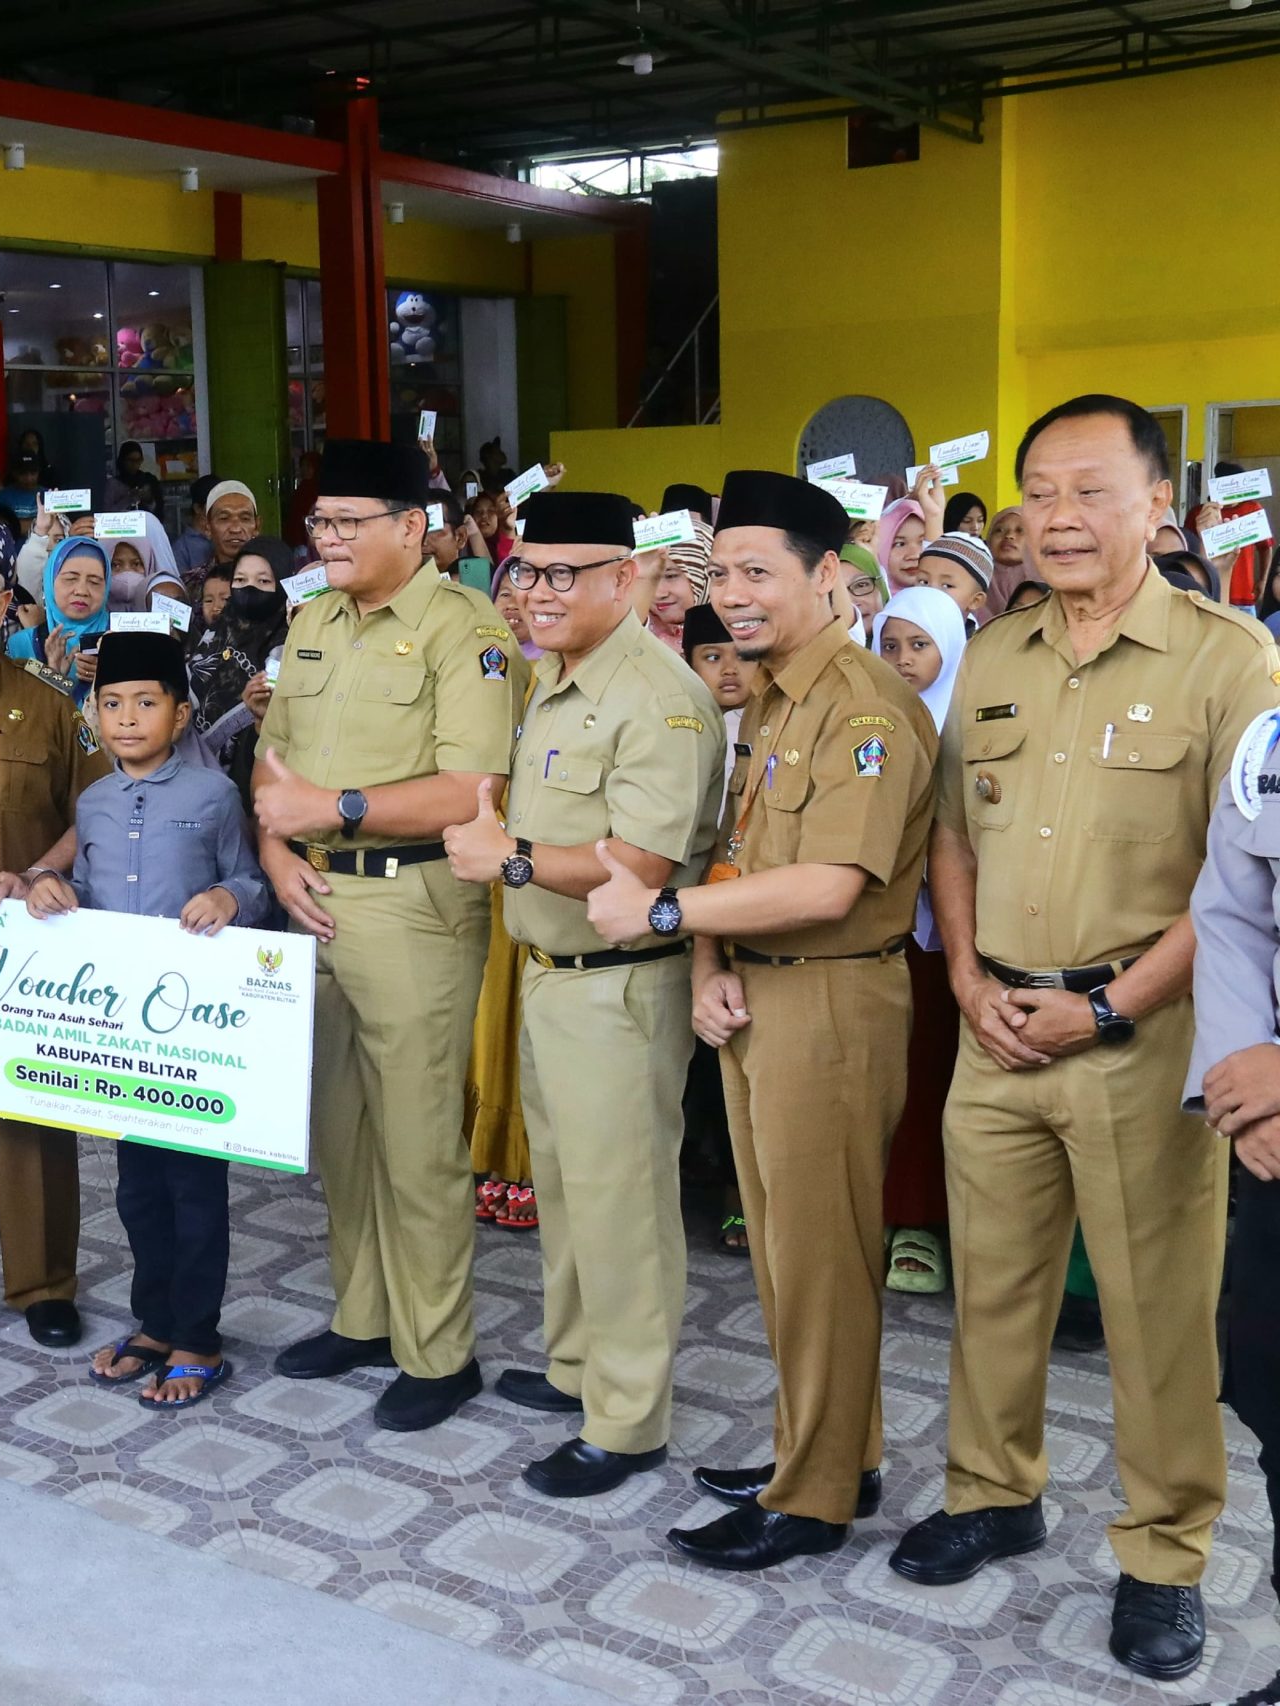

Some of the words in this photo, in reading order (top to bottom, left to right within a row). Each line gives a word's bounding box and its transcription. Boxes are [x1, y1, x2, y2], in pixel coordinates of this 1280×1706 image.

[142, 971, 250, 1034] Oase
[246, 977, 292, 991] BAZNAS
[1, 1003, 34, 1018] Orang
[36, 1008, 56, 1020] Tua
[58, 1012, 86, 1025] Asuh
[87, 1017, 124, 1031] Sehari
[36, 1043, 133, 1071] KABUPATEN
[138, 1060, 198, 1082] BLITAR
[52, 1026, 92, 1044] AMIL
[96, 1033, 152, 1054] ZAKAT
[156, 1043, 248, 1070] NASIONAL
[15, 1064, 79, 1090] Senilai
[95, 1078, 128, 1100] Rp.
[133, 1085, 225, 1116] 400.000
